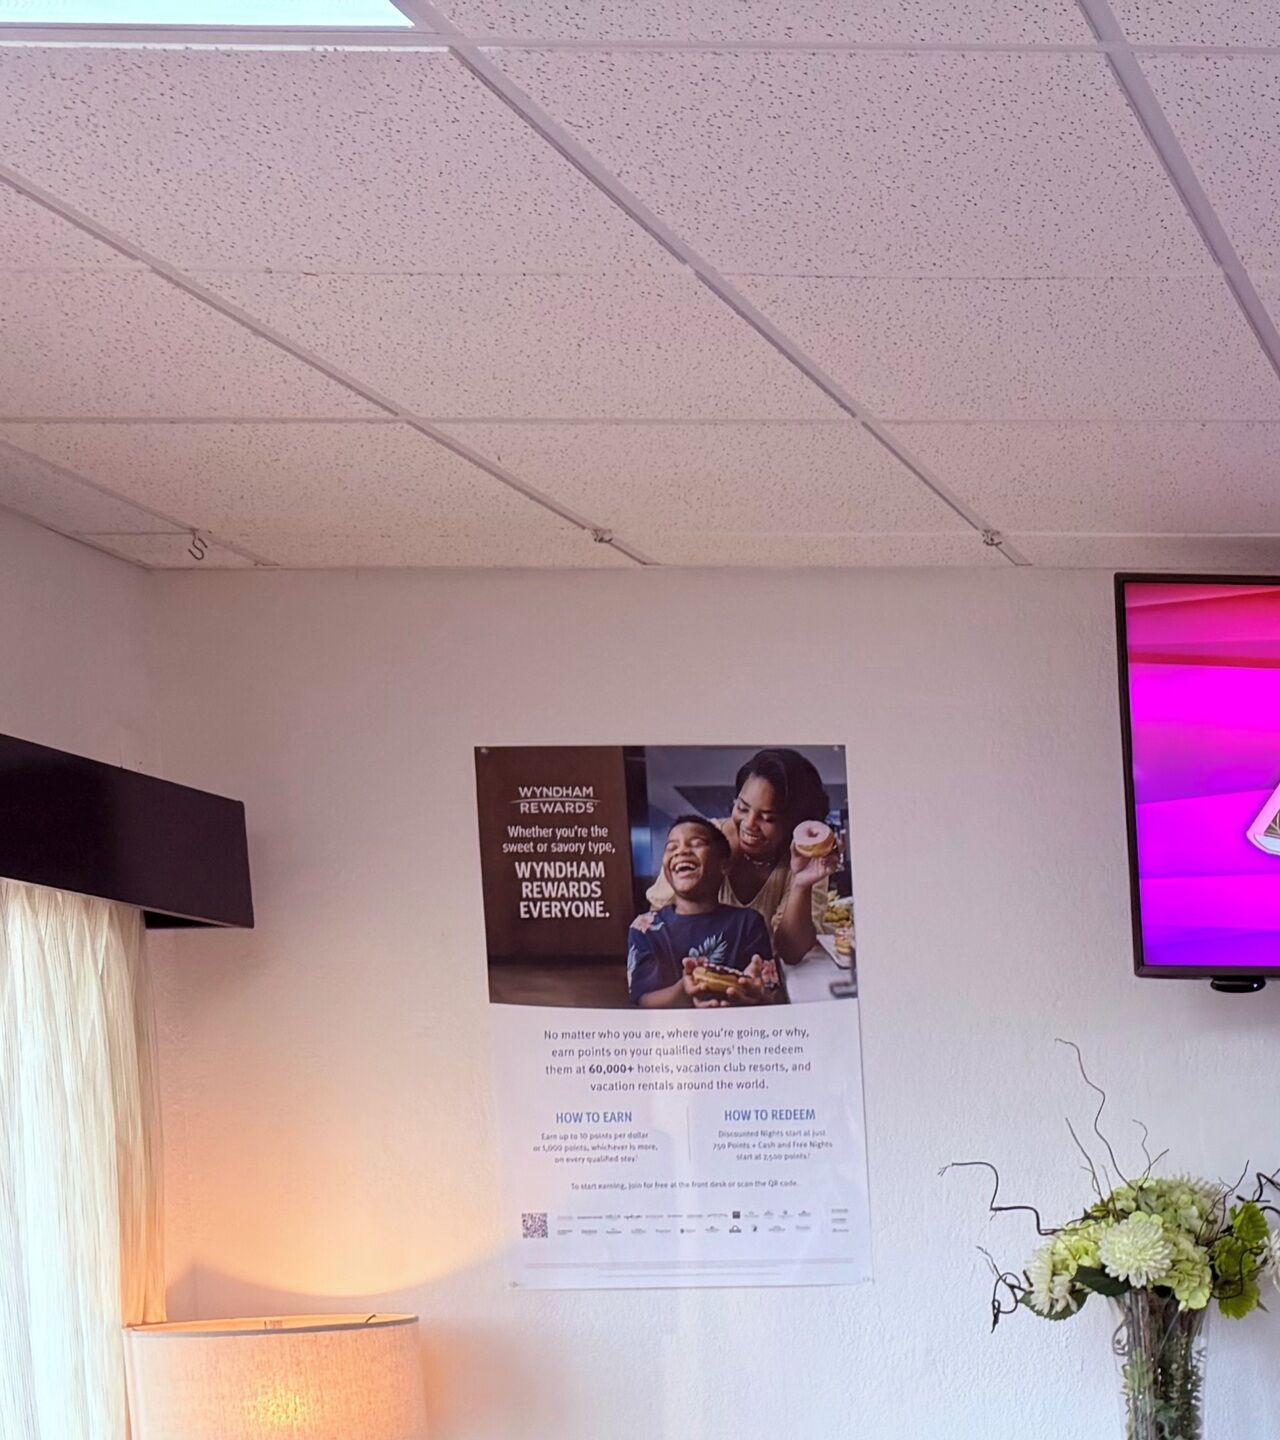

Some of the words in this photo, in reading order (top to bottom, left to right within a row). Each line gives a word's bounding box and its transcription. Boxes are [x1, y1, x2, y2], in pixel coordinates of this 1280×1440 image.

[518, 786, 594, 798] WYNDHAM
[520, 801, 595, 814] REWARDS
[507, 825, 553, 838] Whether
[555, 825, 588, 840] you're
[590, 825, 609, 837] the
[502, 842, 534, 853] sweet
[536, 842, 548, 853] or
[550, 842, 586, 855] savory
[588, 841, 616, 855] type,
[514, 861, 606, 879] WYNDHAM
[521, 881, 602, 899] REWARDS
[520, 901, 610, 919] EVERYONE.
[544, 1030, 558, 1040] No
[561, 1030, 596, 1040] matter
[597, 1029, 621, 1040] who
[622, 1030, 642, 1041] you
[644, 1030, 665, 1040] are,
[666, 1028, 699, 1039] where
[701, 1028, 735, 1040] you're
[736, 1027, 770, 1040] going,
[771, 1029, 783, 1037] or
[785, 1027, 809, 1038] why,
[551, 1048, 575, 1058] earn
[577, 1047, 612, 1059] points
[613, 1047, 627, 1057] on
[629, 1046, 653, 1058] your
[655, 1044, 702, 1058] qualified
[737, 1044, 761, 1055] then
[763, 1044, 804, 1055] redeem
[545, 1064, 573, 1075] them
[575, 1065, 586, 1074] at
[588, 1063, 635, 1075] 60,000+
[637, 1063, 674, 1074] hotels,
[675, 1062, 721, 1073] vacation
[723, 1061, 746, 1072] club
[748, 1062, 789, 1073] resorts,
[791, 1061, 811, 1071] and
[590, 1081, 635, 1092] vacation
[637, 1080, 675, 1091] rentals
[676, 1079, 714, 1090] around
[716, 1079, 734, 1089] the
[735, 1079, 769, 1089] world.
[556, 1112, 583, 1123] HOW
[585, 1112, 600, 1122] TO
[603, 1111, 633, 1122] EARN
[724, 1109, 751, 1121] HOW
[754, 1109, 768, 1120] TO
[771, 1109, 816, 1120] REDEEM
[589, 1132, 612, 1140] points
